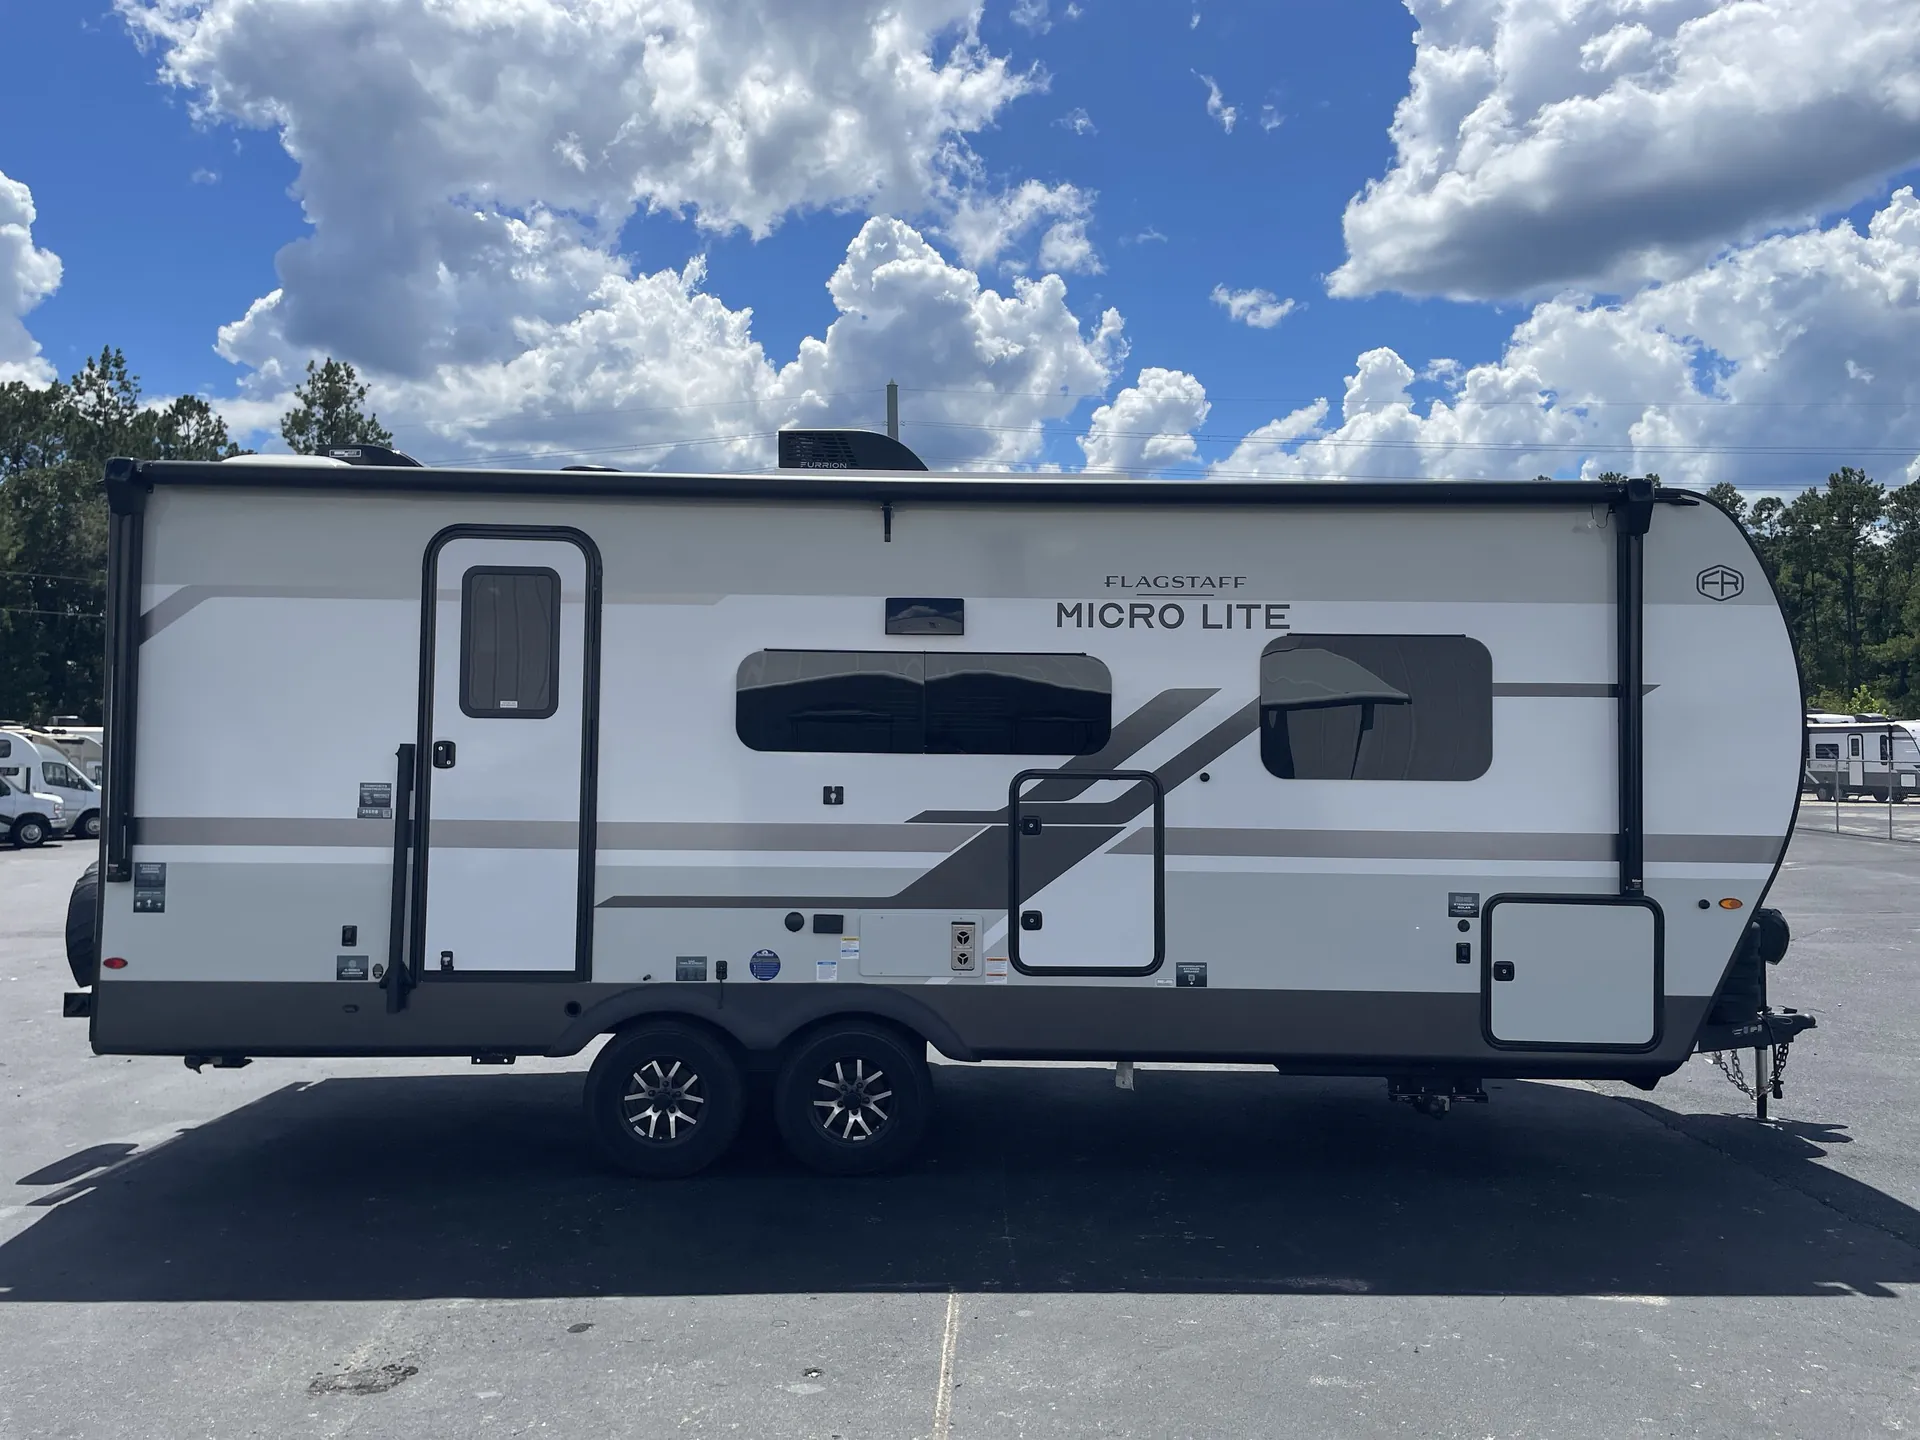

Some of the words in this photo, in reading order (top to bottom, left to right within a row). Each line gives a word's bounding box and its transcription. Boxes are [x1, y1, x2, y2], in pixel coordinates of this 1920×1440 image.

[1104, 575, 1247, 588] FLAGSTAFF
[1056, 602, 1185, 629] MICRO
[1202, 604, 1291, 630] LITE
